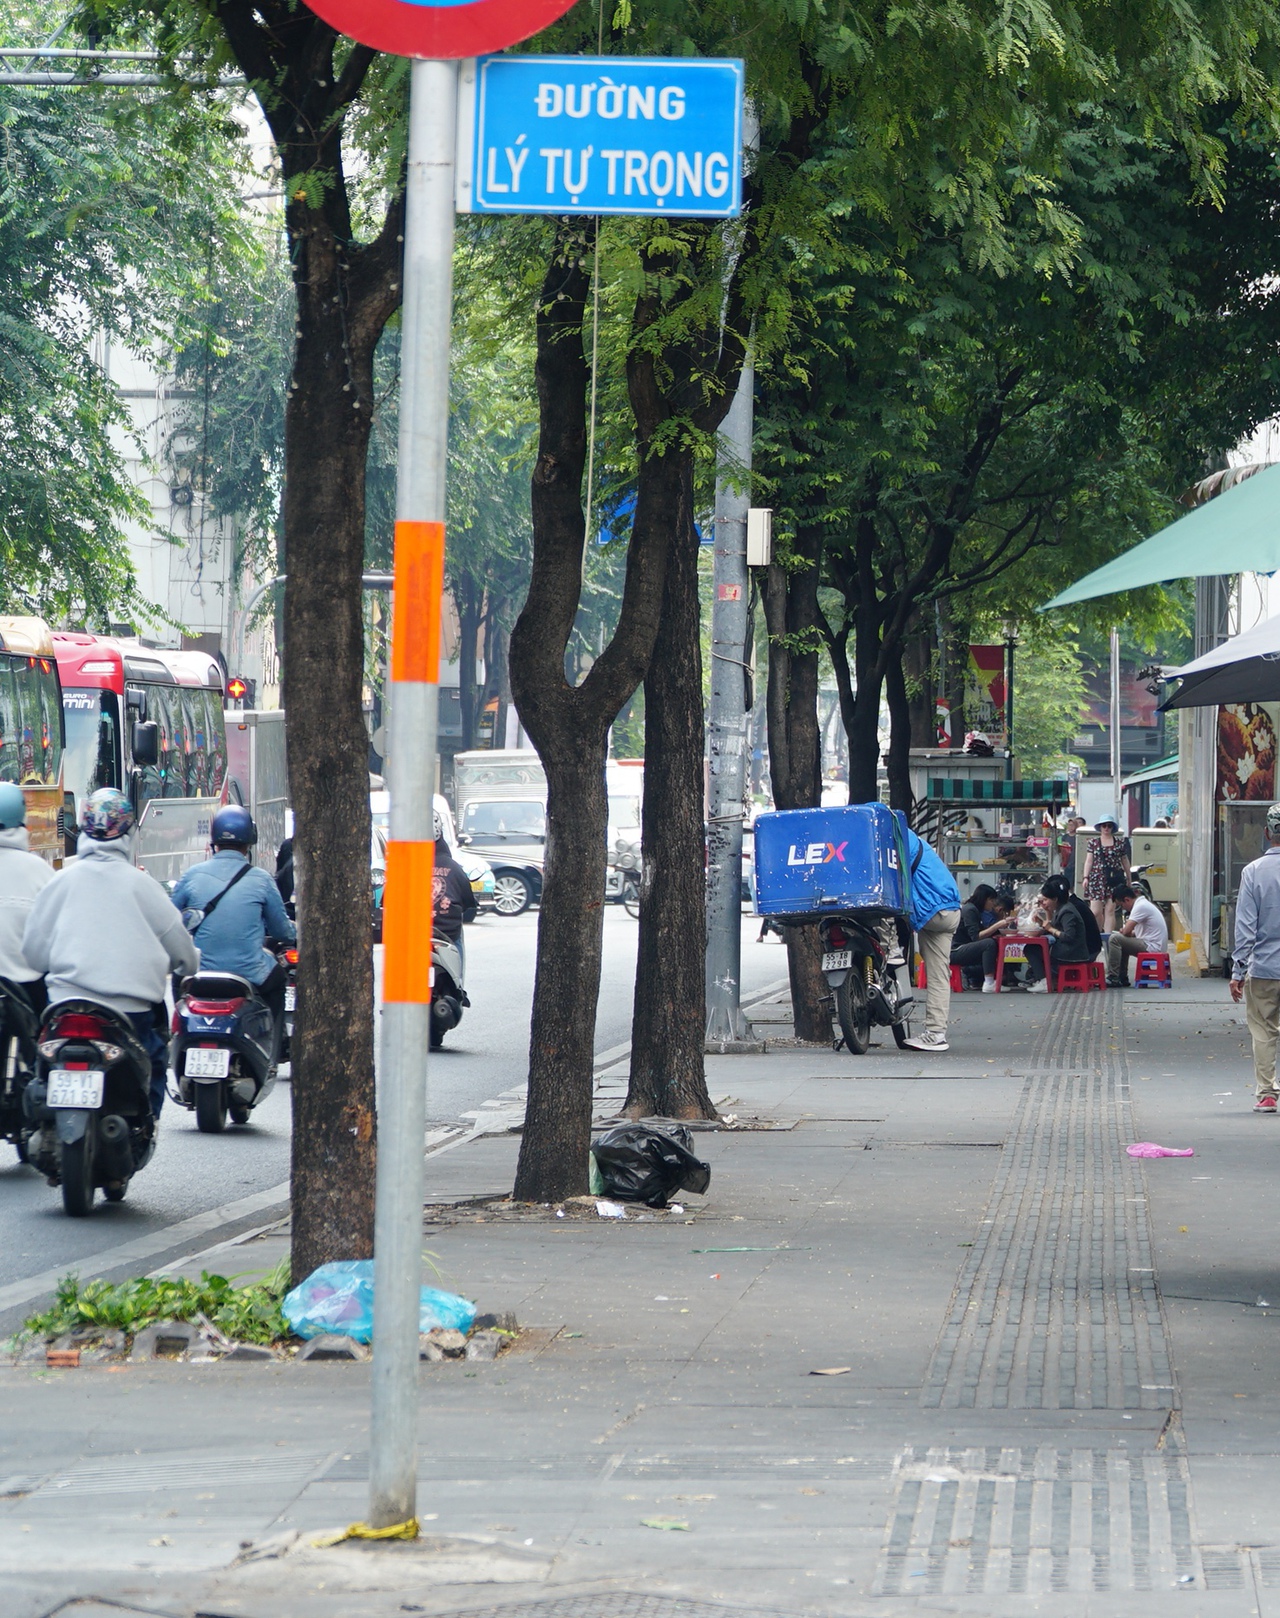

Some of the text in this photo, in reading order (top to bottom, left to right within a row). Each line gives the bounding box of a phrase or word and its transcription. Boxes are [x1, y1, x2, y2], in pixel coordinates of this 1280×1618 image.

[534, 76, 686, 121] ĐƯỜNG
[486, 133, 729, 207] LÝ TỰ TRỌNG
[62, 699, 95, 709] mini
[787, 841, 849, 866] LEX
[887, 848, 899, 869] LE
